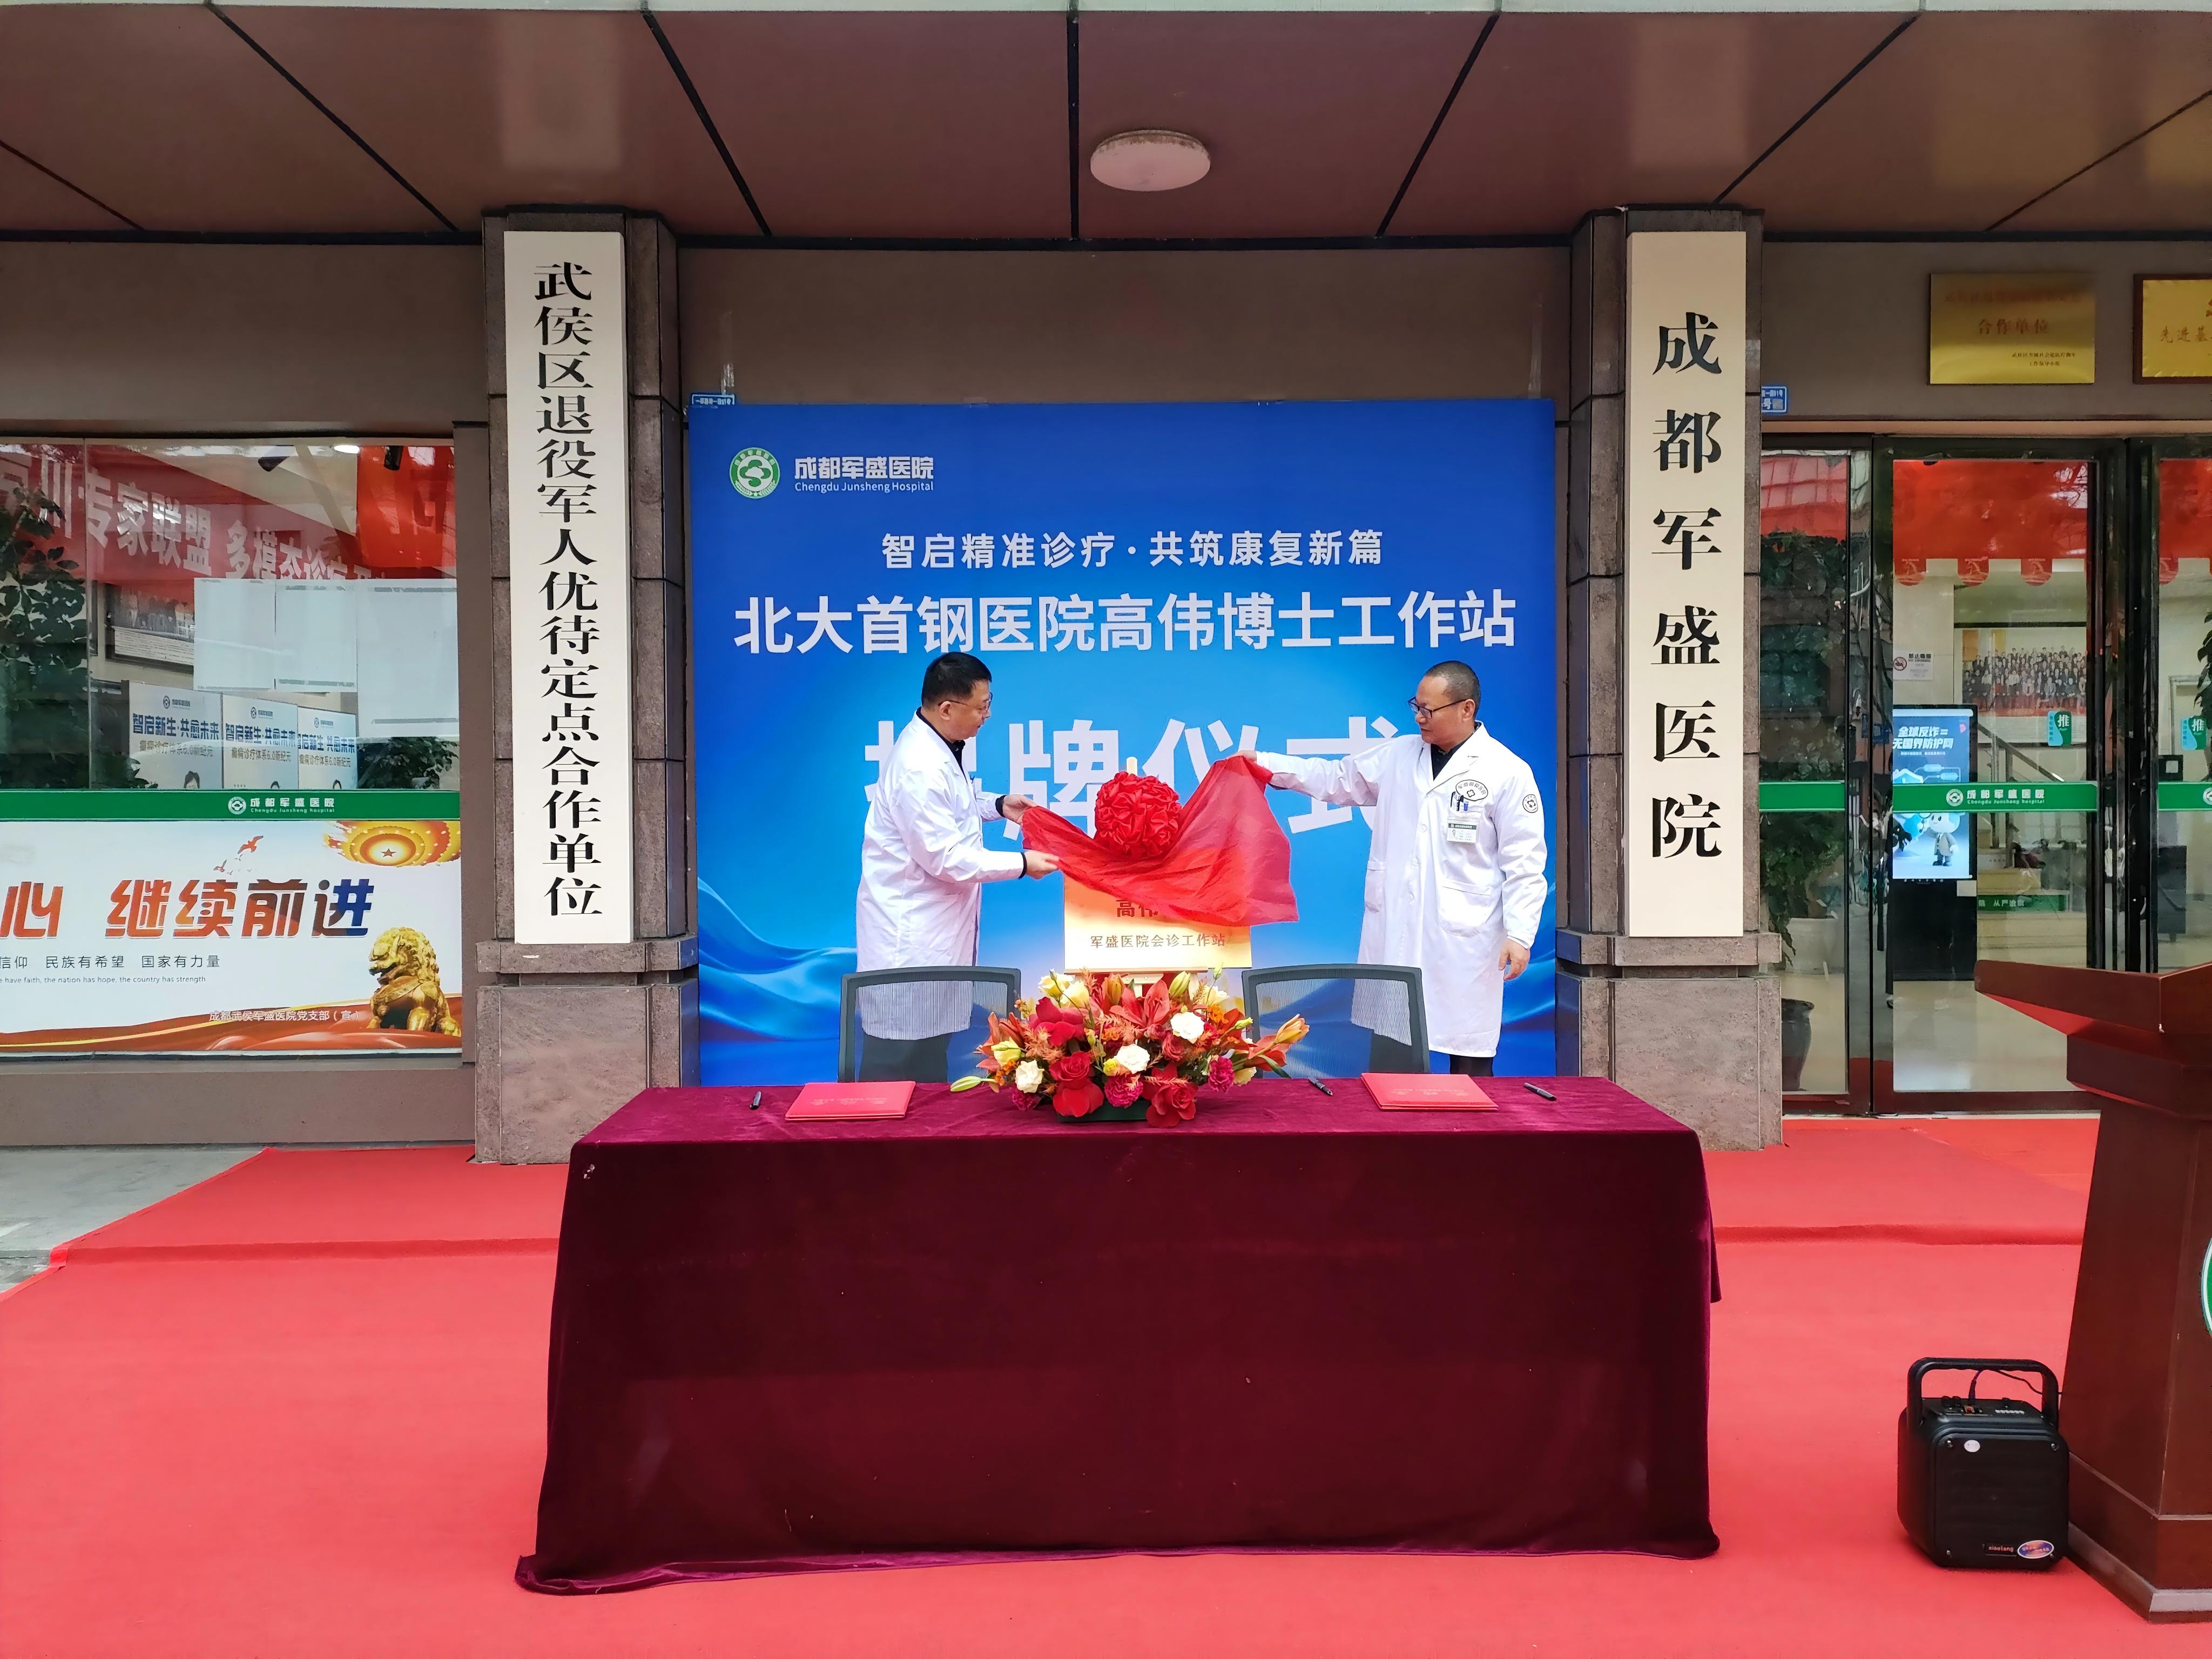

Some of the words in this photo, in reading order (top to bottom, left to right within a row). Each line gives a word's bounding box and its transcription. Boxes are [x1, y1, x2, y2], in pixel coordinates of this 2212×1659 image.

[1979, 319, 2048, 334] 合作单位
[2161, 325, 2212, 343] 先进基
[795, 456, 934, 479] 成都军盛医院
[795, 482, 839, 493] Chengdu
[842, 482, 890, 493] Junsheng
[892, 482, 934, 493] Hospital
[0, 453, 212, 576] 川专家联盟
[882, 529, 1382, 569] 智启精准诊疗·共筑康复新篇
[534, 262, 603, 916] 武侯区退役军人优待定点合作单位
[1651, 312, 1722, 859] 成都军盛医院
[734, 589, 1516, 653] 北大首钢医院高伟博士工作站
[2058, 714, 2069, 727] 推
[2191, 719, 2204, 731] 推
[1892, 738, 1954, 749] 无国界防护网
[865, 716, 1399, 840] 牌式
[250, 798, 334, 807] 成都军盛医院
[105, 879, 375, 938] 继续前进
[1090, 933, 1225, 948] 军盛医院会诊工作站
[46, 955, 125, 968] 民族有希望
[141, 955, 220, 968] 国家有力量
